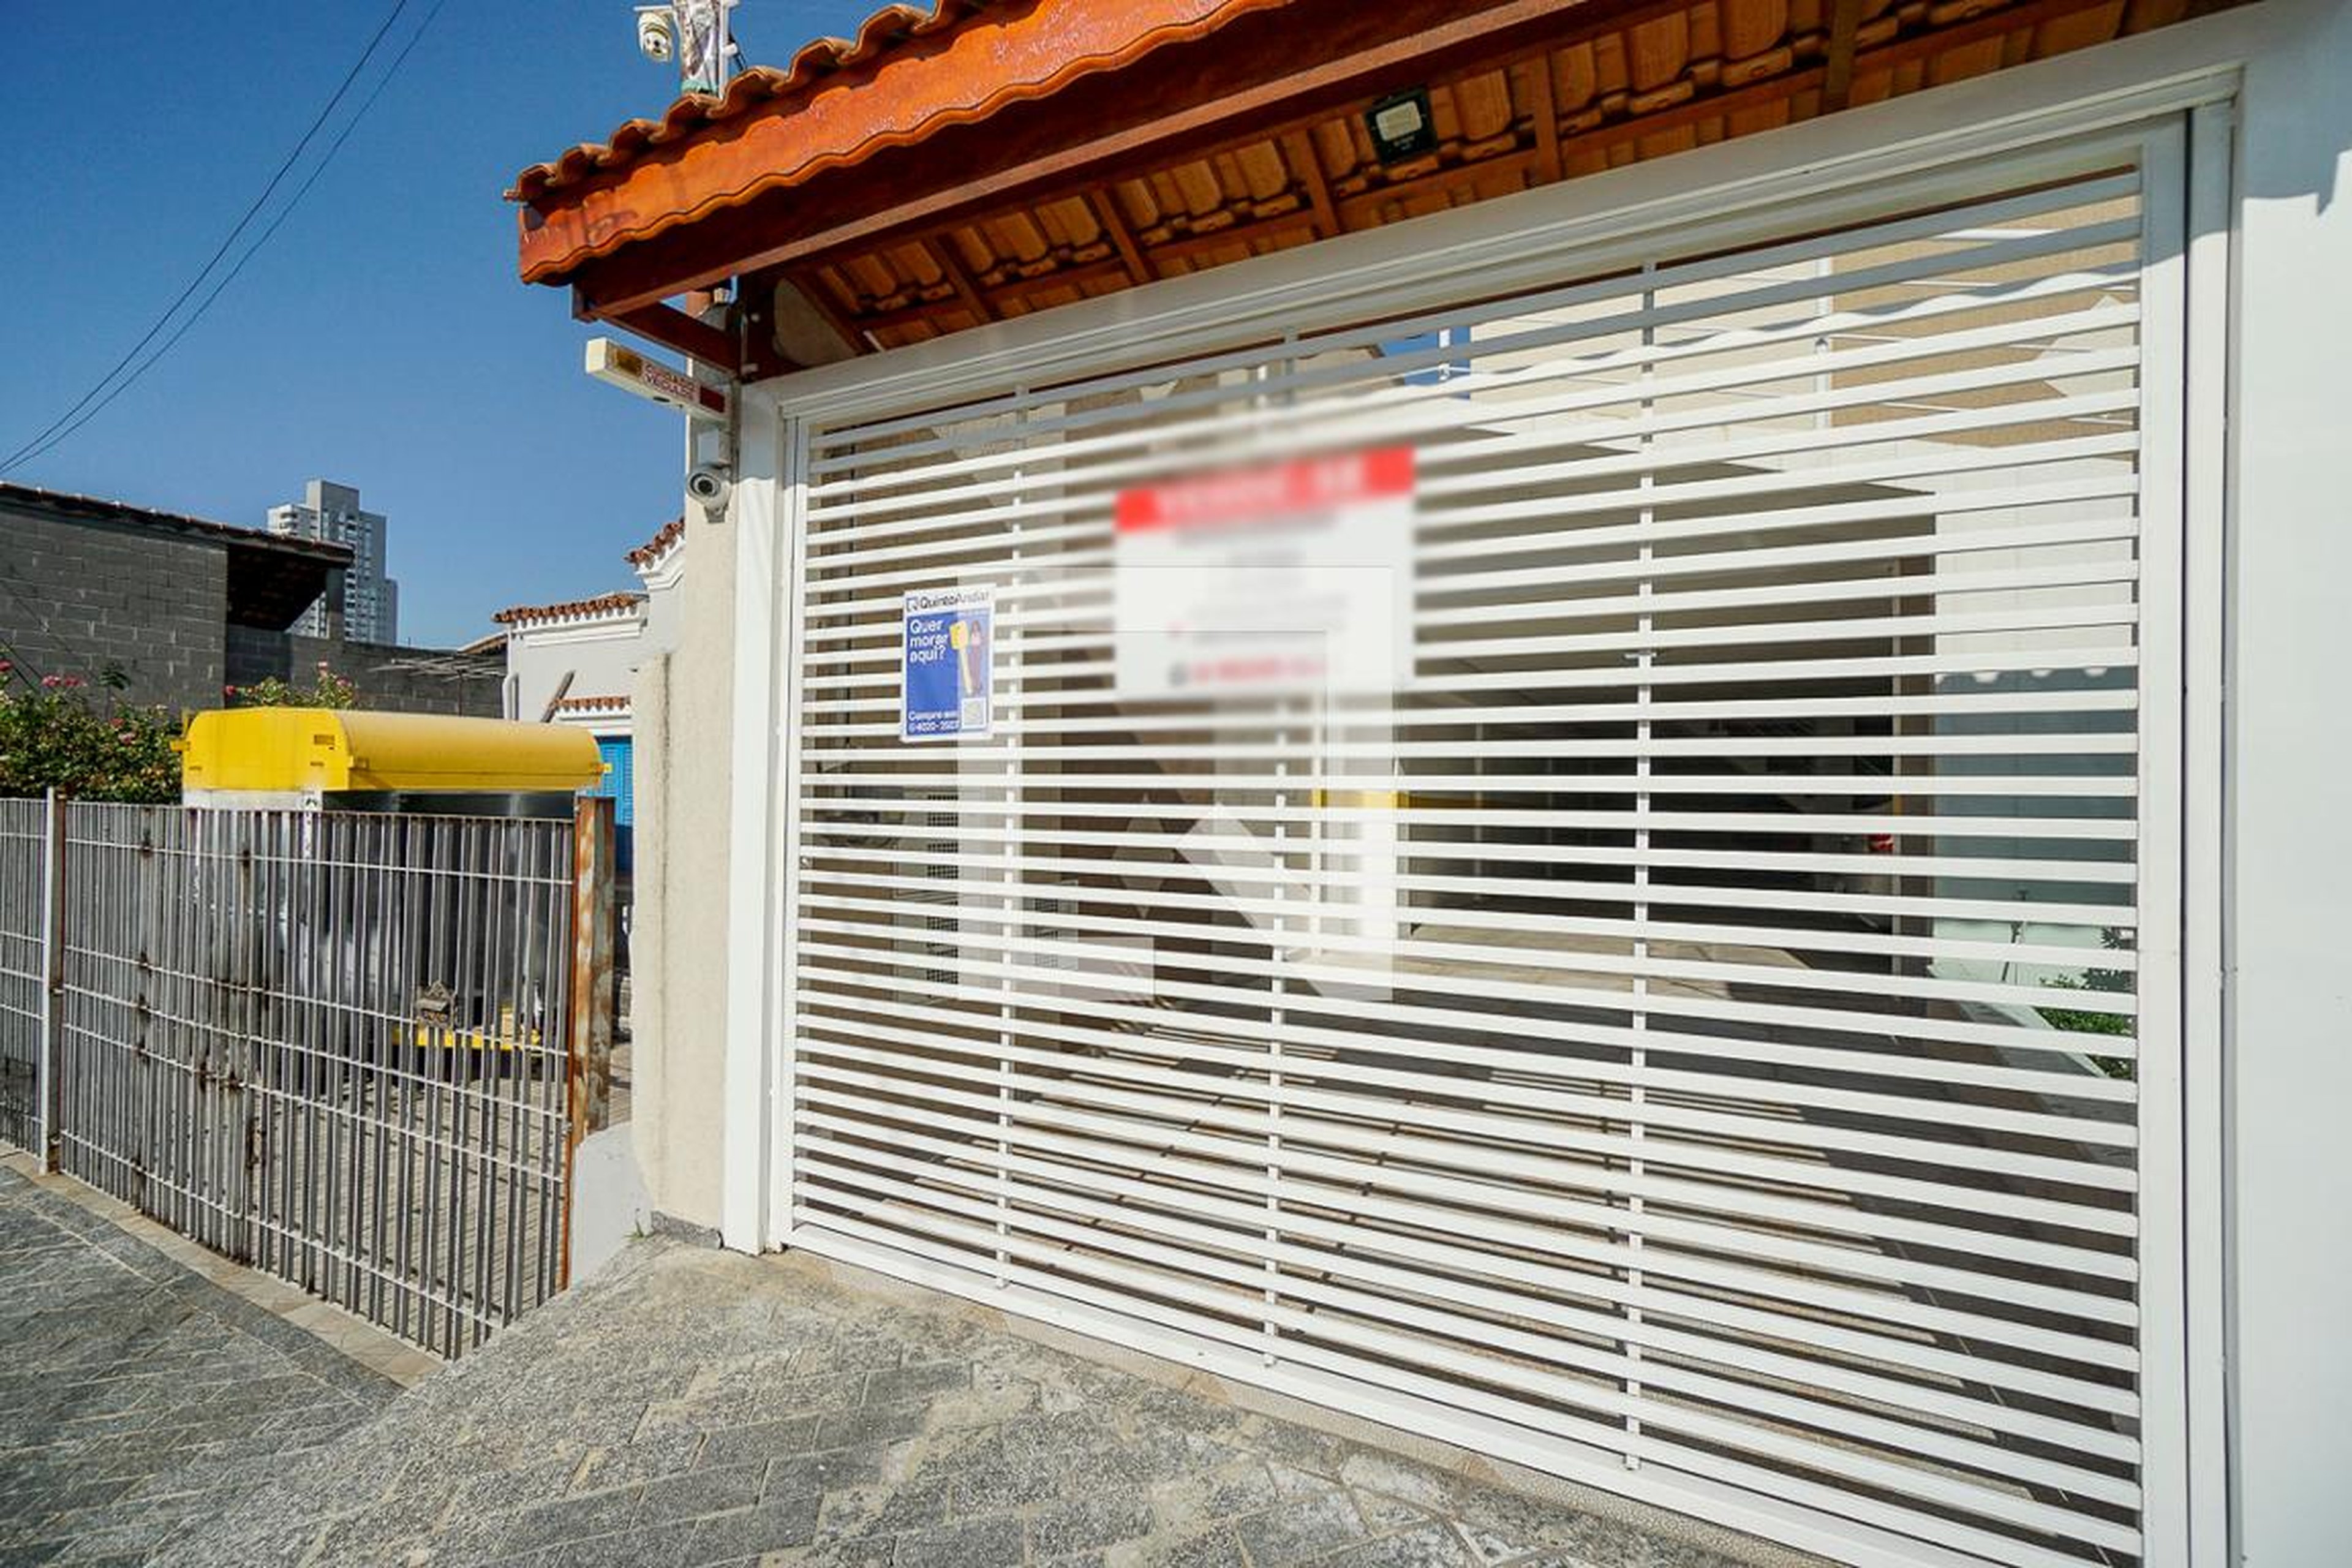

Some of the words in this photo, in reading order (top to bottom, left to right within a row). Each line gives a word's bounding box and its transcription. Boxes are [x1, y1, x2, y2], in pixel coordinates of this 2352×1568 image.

[910, 619, 943, 635] Quer
[910, 633, 948, 648] morar
[910, 646, 946, 665] aqui?
